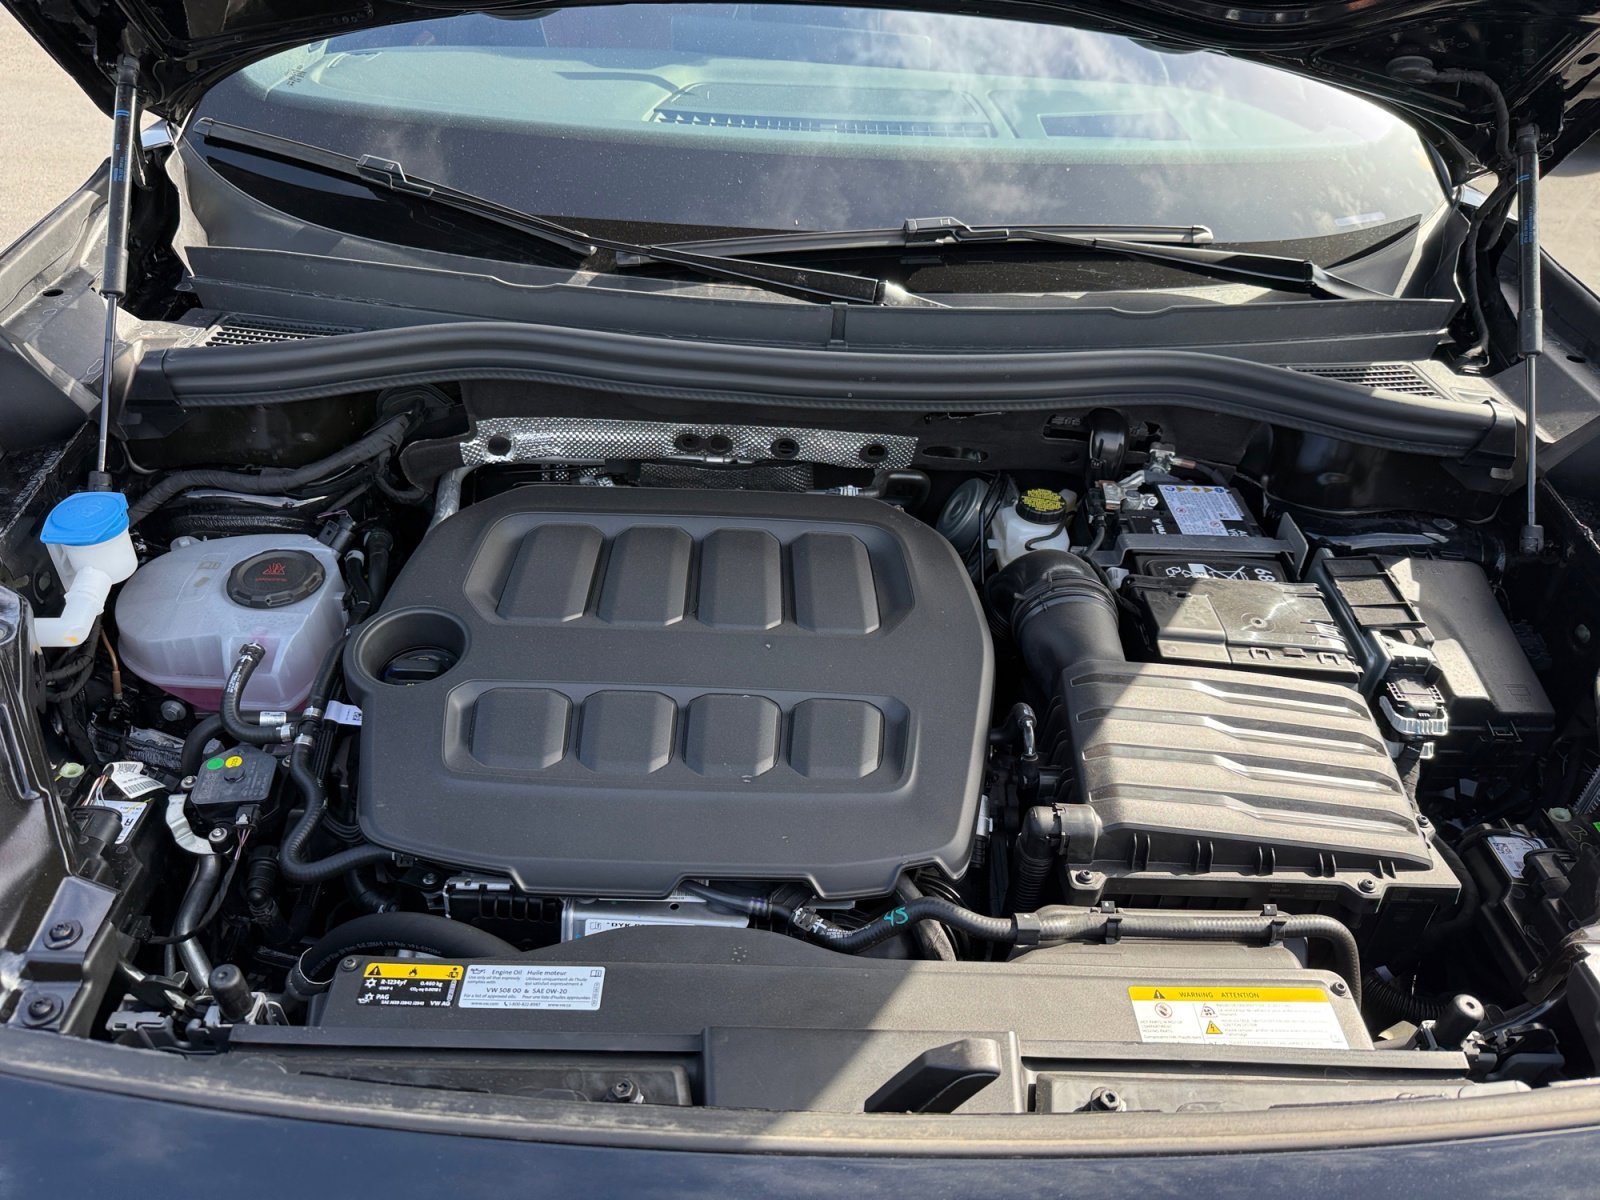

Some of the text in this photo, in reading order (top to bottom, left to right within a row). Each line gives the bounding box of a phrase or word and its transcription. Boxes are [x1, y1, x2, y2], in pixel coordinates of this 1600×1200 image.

[883, 906, 908, 927] 45
[380, 979, 407, 987] R-1234yf
[1220, 991, 1260, 999] ATTENTION
